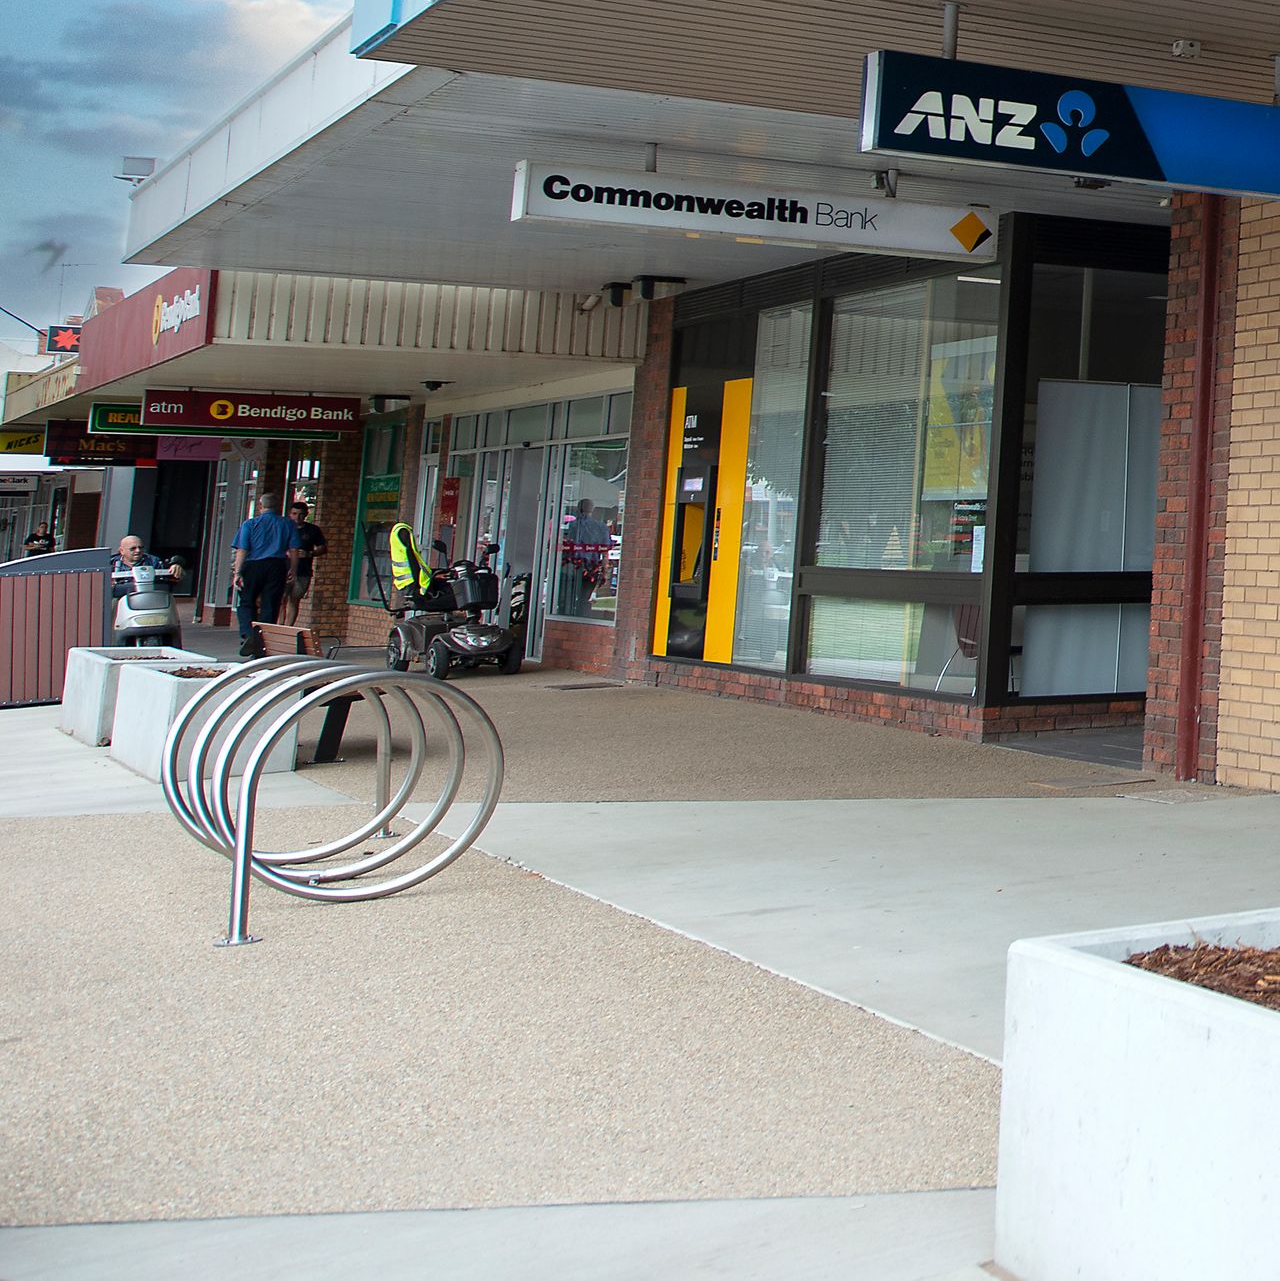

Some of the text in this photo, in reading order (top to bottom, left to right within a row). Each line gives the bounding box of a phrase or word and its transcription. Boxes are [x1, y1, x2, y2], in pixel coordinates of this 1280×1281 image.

[894, 90, 1037, 150] ANZ
[542, 174, 879, 231] Commonwealth Bank
[150, 401, 353, 421] atm Bendigo Bank
[78, 439, 126, 452] Mac's
